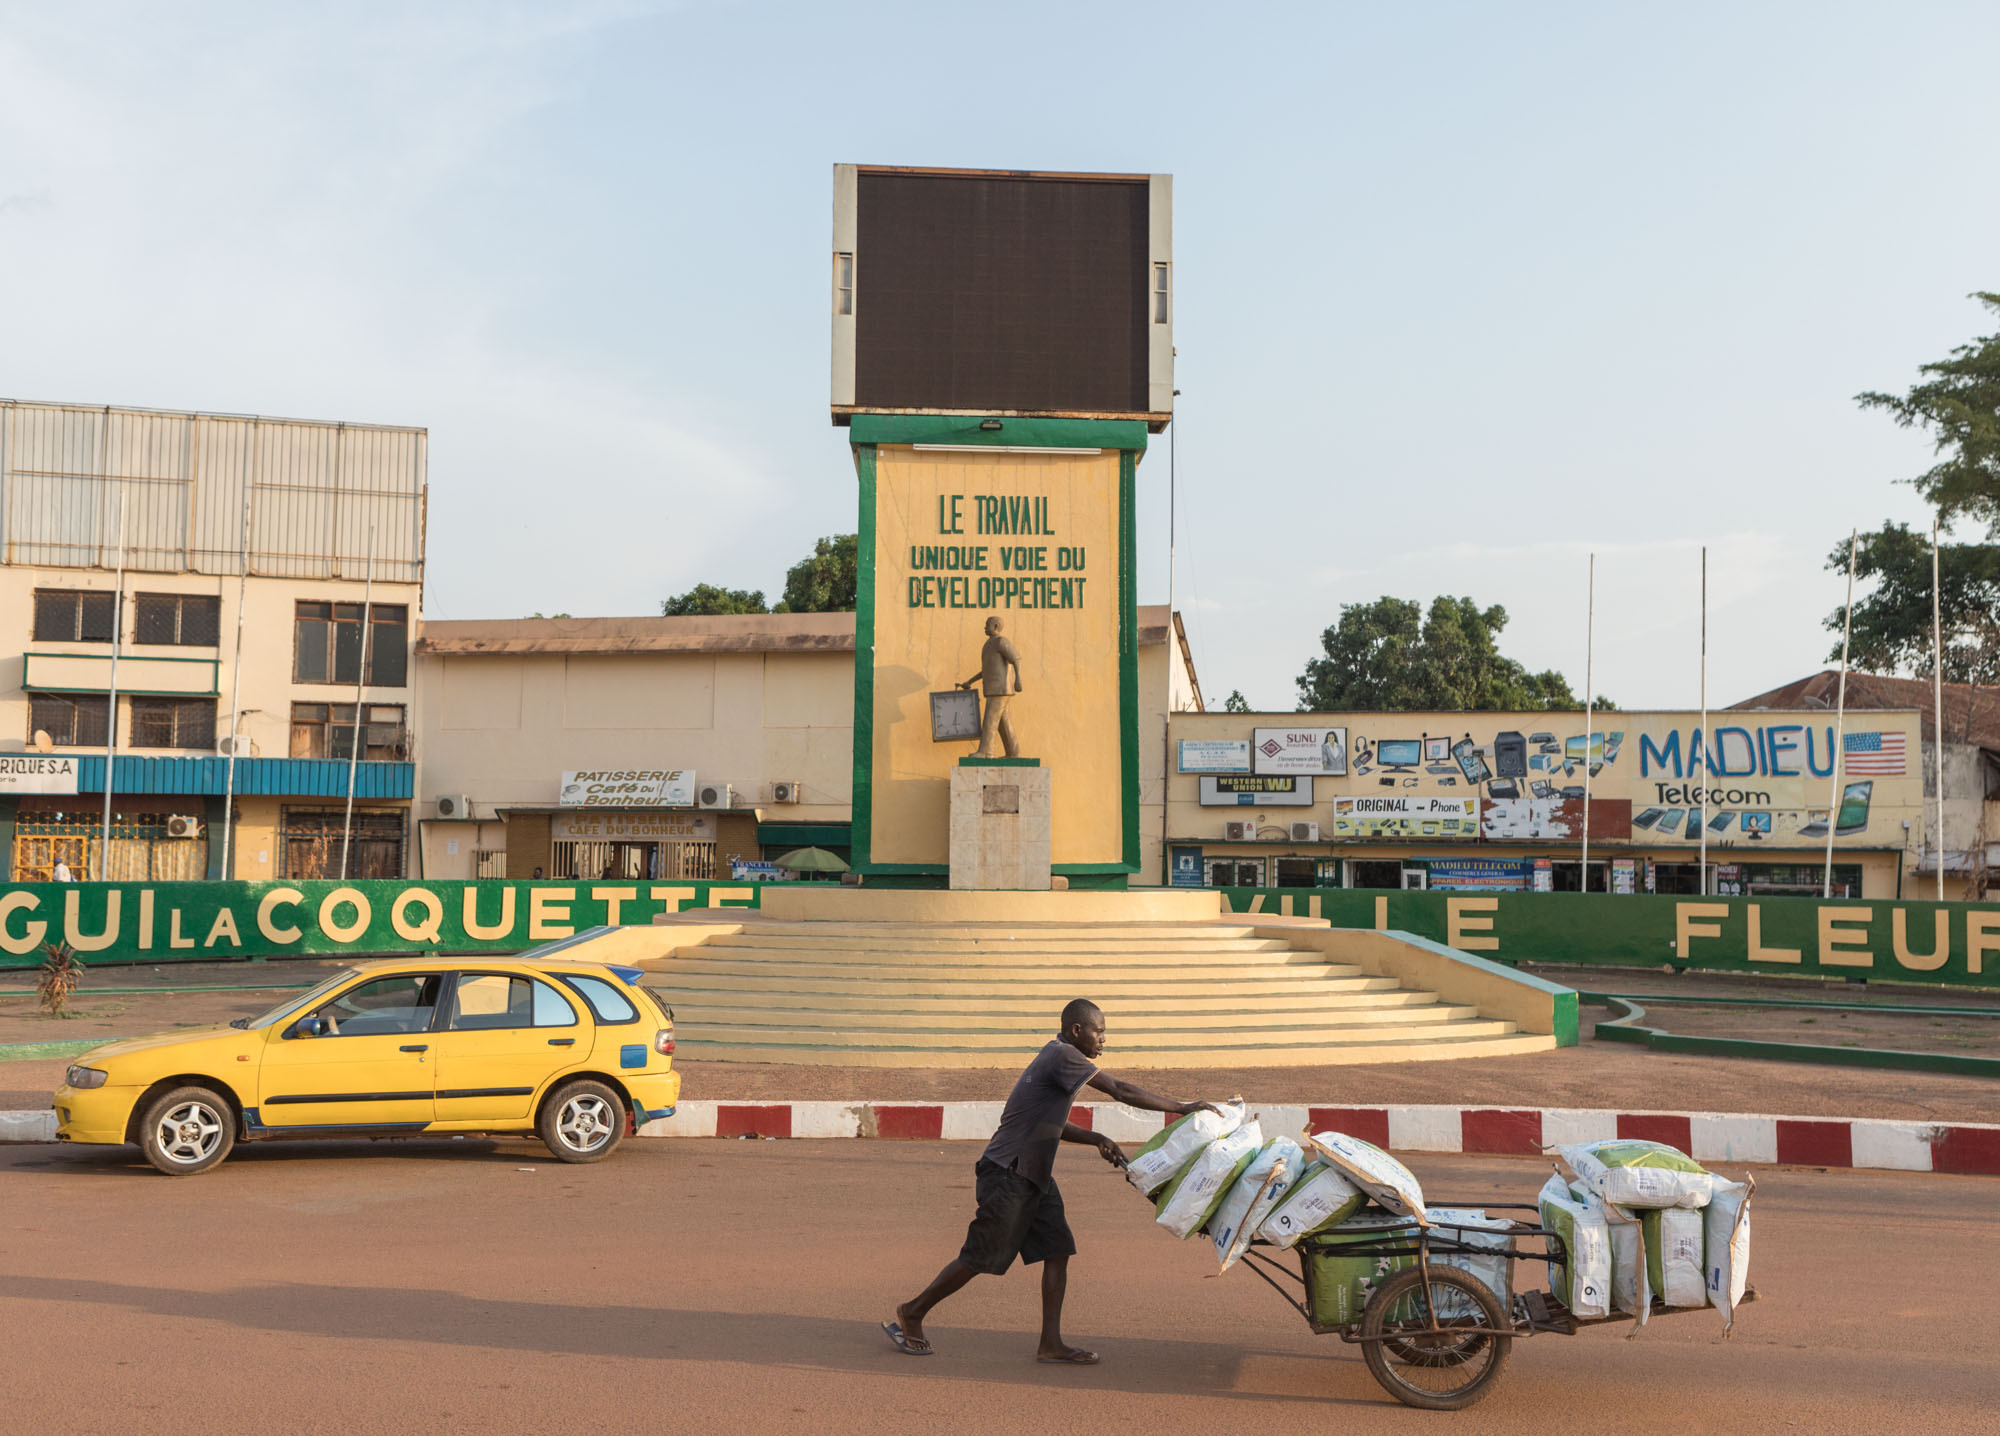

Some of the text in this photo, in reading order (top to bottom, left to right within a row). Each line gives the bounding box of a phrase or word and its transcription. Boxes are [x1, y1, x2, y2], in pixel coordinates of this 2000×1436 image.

[939, 494, 1056, 536] LE TRAVAIL
[911, 545, 1086, 571] UNIQUE VOIE DU
[907, 576, 1087, 609] DEVELOPPEMENT
[1286, 733, 1317, 743] SUNU
[1639, 725, 1836, 778] MADIEU
[573, 770, 683, 782] PATISSERIE
[1220, 777, 1263, 785] WESTERN
[586, 782, 655, 794] Café Du
[1655, 782, 1771, 805] Telecom
[583, 794, 669, 806] Bonheur
[1356, 799, 1409, 812] ORIGINAL
[1430, 799, 1460, 812] Phone
[568, 825, 694, 835] CAFE DU BONHEUR
[1430, 862, 1521, 870] MADIEU TELECOM
[0, 889, 155, 955] GUI
[169, 907, 242, 949] LA
